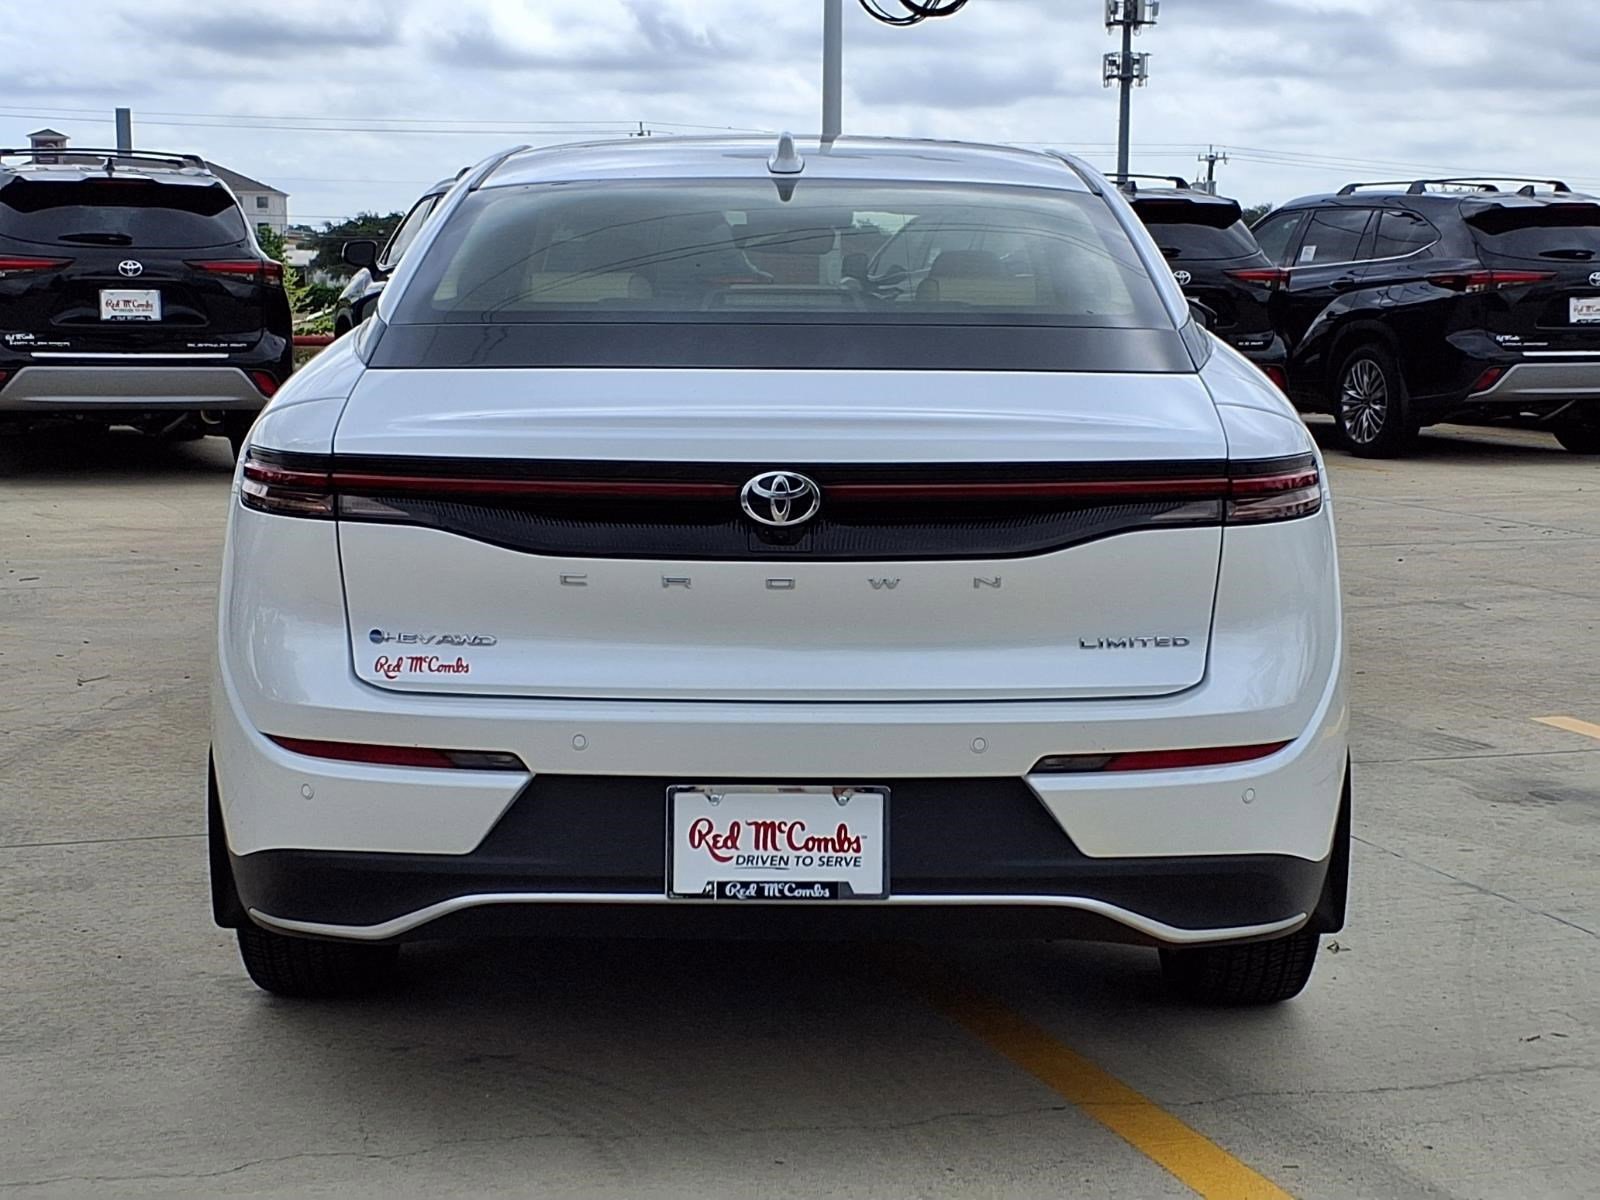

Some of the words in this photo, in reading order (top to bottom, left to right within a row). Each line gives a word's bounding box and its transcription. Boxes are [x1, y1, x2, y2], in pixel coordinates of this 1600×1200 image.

[560, 572, 1001, 590] CROWN
[1079, 636, 1190, 650] LIMITED
[374, 655, 403, 679] Red
[406, 655, 470, 674] McCombs
[689, 817, 741, 863] Red
[746, 819, 862, 854] McCombs
[735, 854, 790, 867] DRIVEN
[794, 855, 814, 867] TO
[817, 856, 862, 867] SERVE
[725, 883, 757, 899] Red
[759, 883, 831, 898] McCombs
